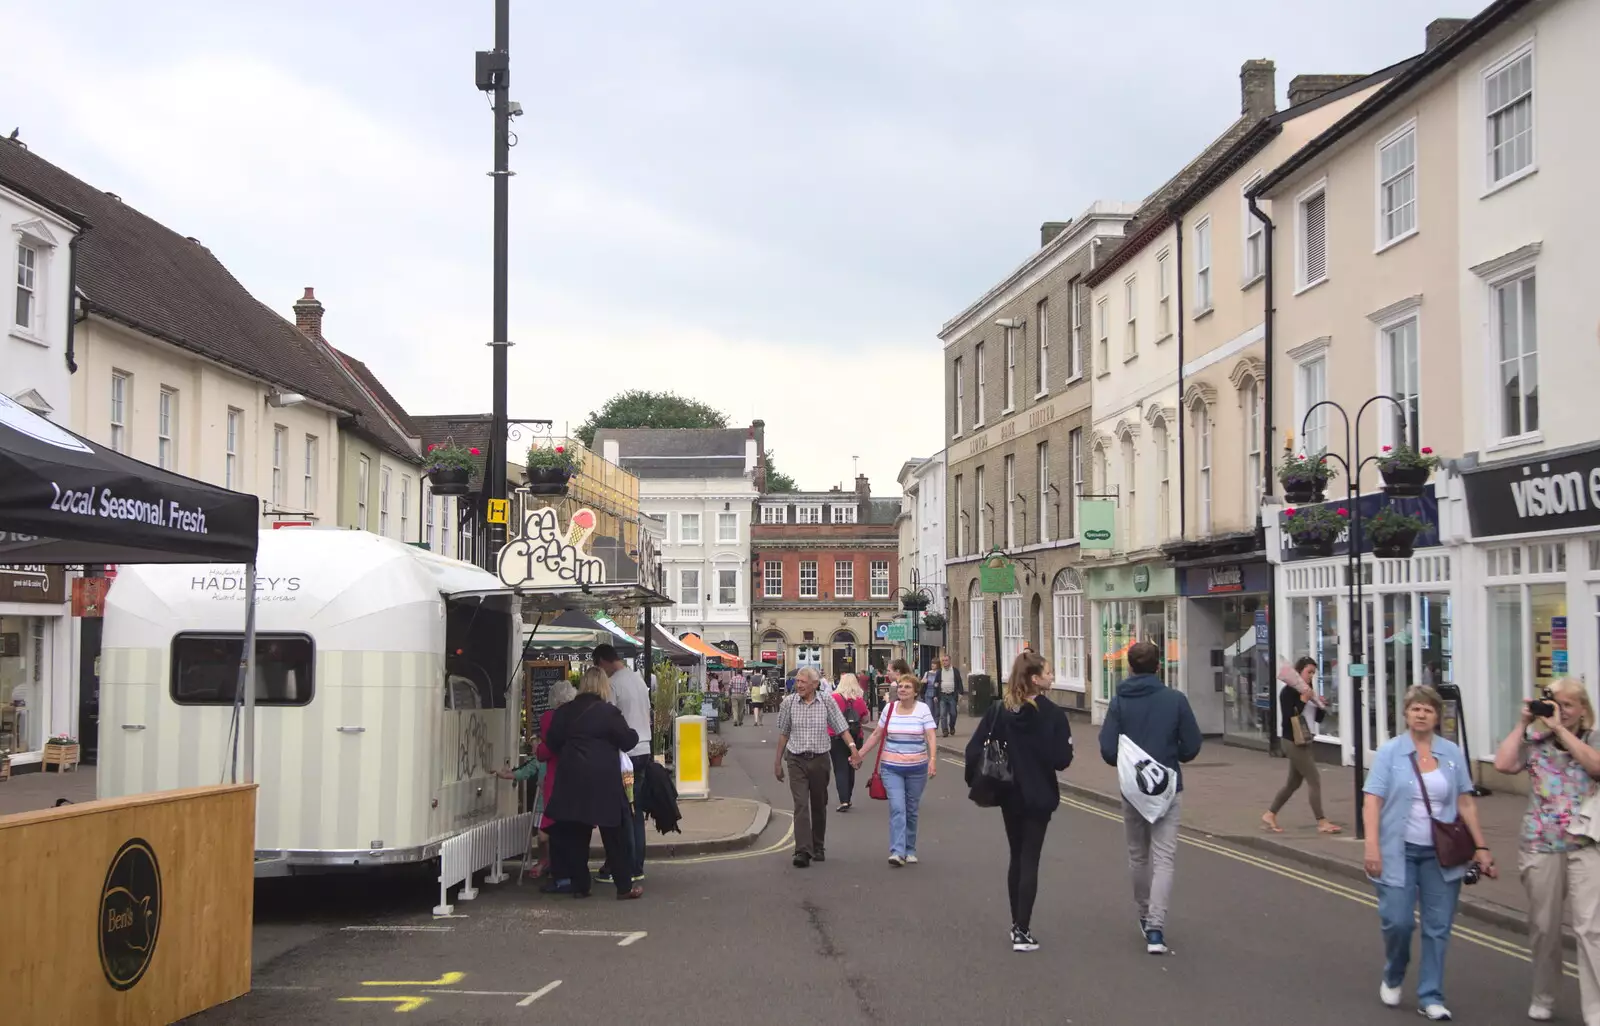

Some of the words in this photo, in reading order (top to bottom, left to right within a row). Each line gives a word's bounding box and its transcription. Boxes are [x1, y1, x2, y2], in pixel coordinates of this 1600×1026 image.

[50, 481, 95, 516] Local.
[99, 488, 165, 527] Seasonal.
[168, 499, 208, 535] Fresh.
[491, 501, 506, 521] H
[1510, 462, 1587, 518] vision
[516, 489, 556, 543] Ice
[191, 576, 301, 591] HADLEY'S
[499, 539, 604, 587] Cream
[107, 907, 133, 932] Ben's
